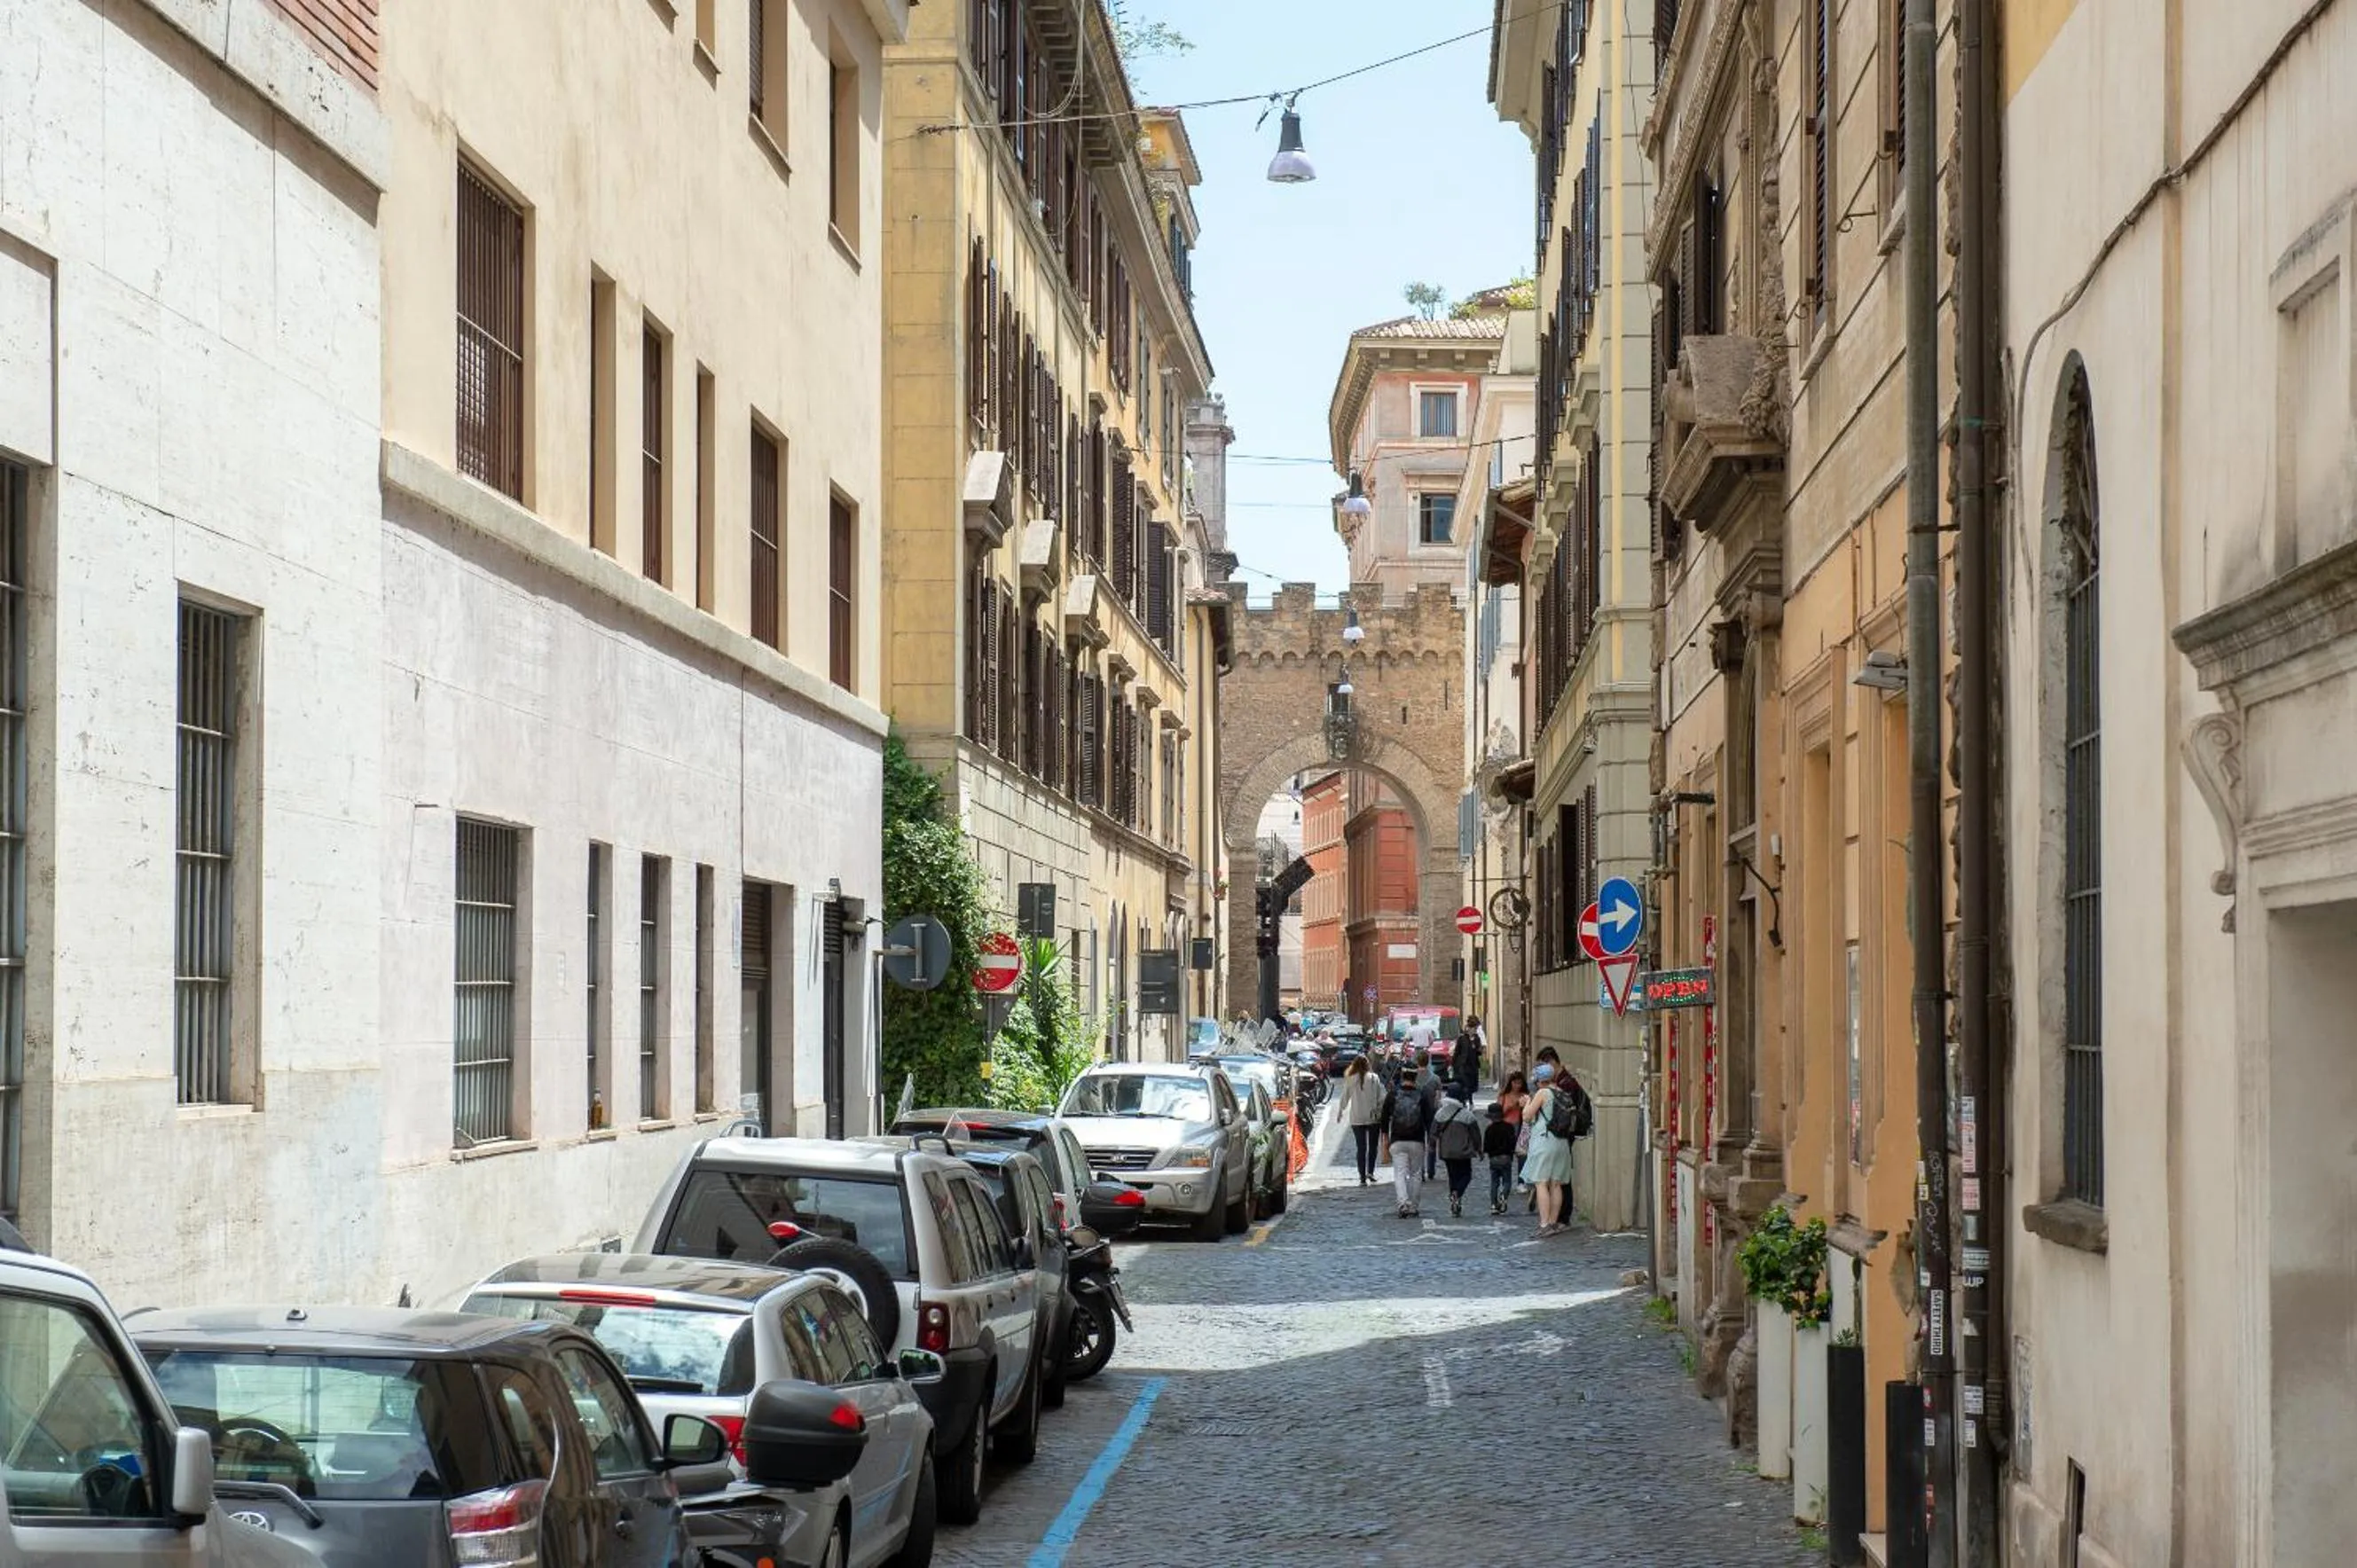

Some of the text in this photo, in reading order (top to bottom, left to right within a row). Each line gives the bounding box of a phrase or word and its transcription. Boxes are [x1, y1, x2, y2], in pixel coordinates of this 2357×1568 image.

[1648, 978, 1709, 1000] OPEN
[1932, 1290, 1943, 1353] SAFETY THIRD
